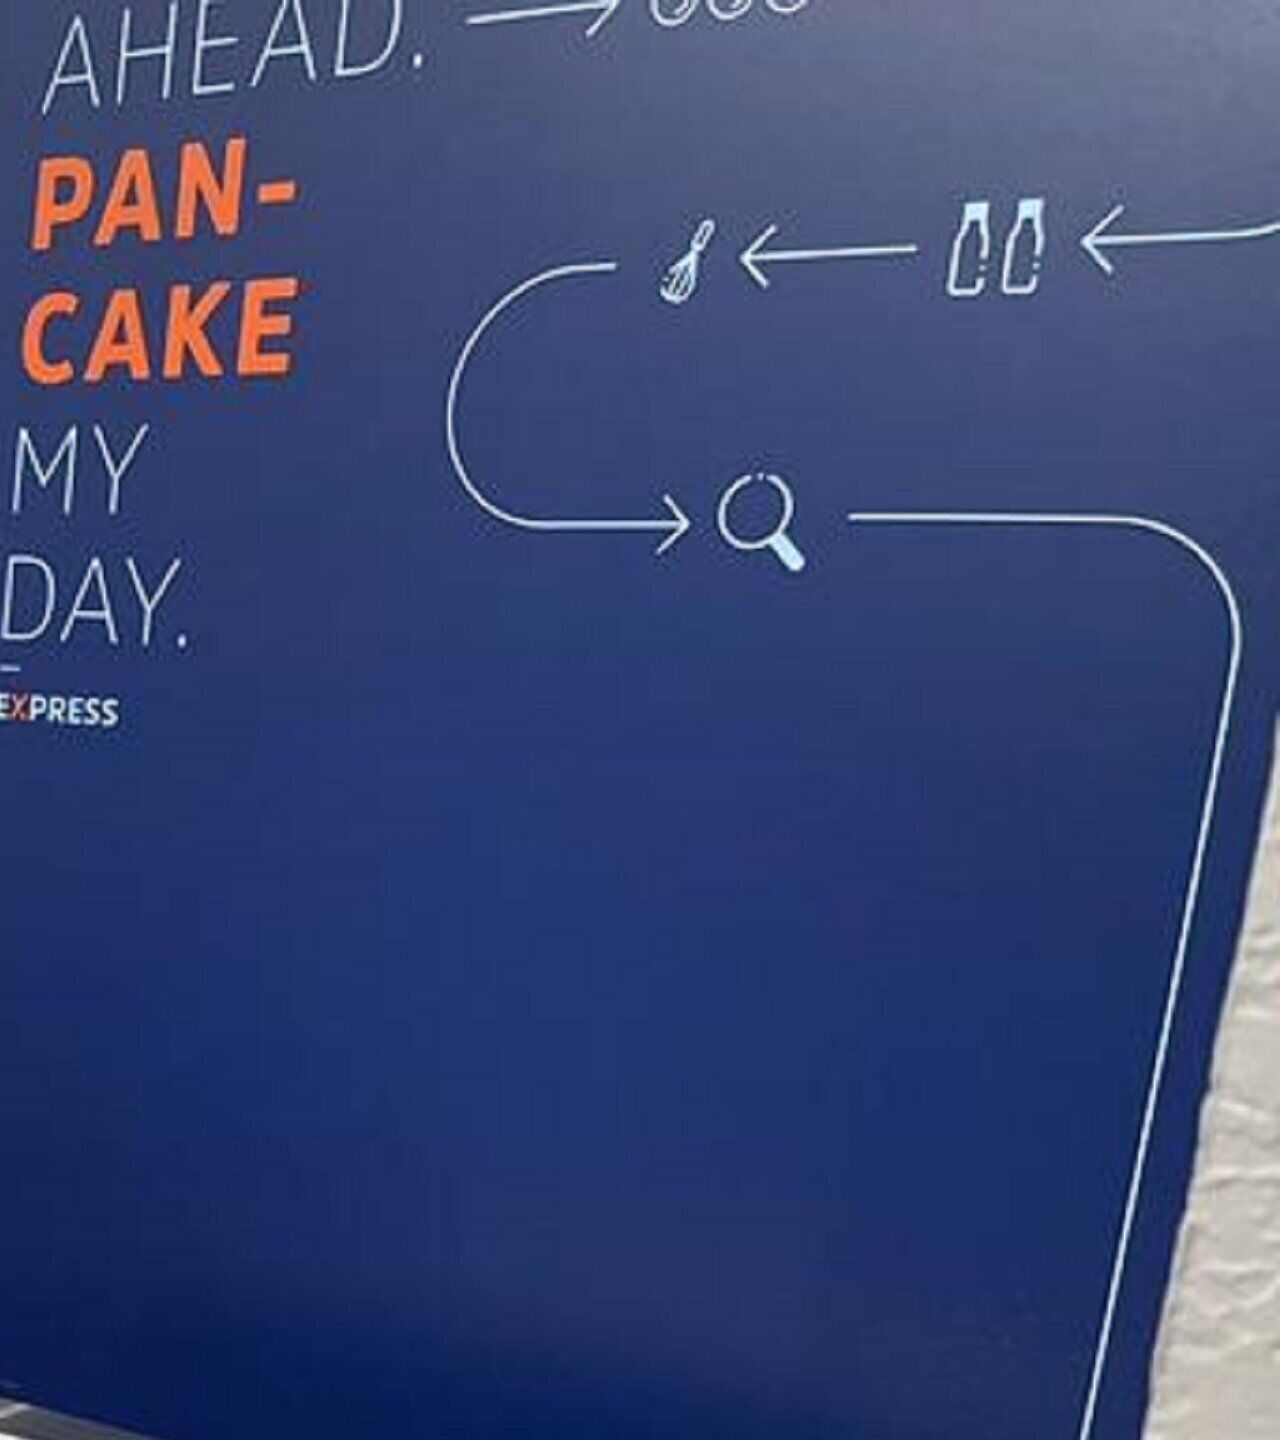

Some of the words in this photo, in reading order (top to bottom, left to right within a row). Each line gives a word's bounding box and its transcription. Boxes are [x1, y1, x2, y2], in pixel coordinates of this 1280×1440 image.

[42, 0, 423, 115] AHEAD.
[31, 137, 297, 251] PAN-
[21, 277, 300, 385] CAKE
[12, 424, 150, 515] MY
[0, 555, 188, 648] DAY.
